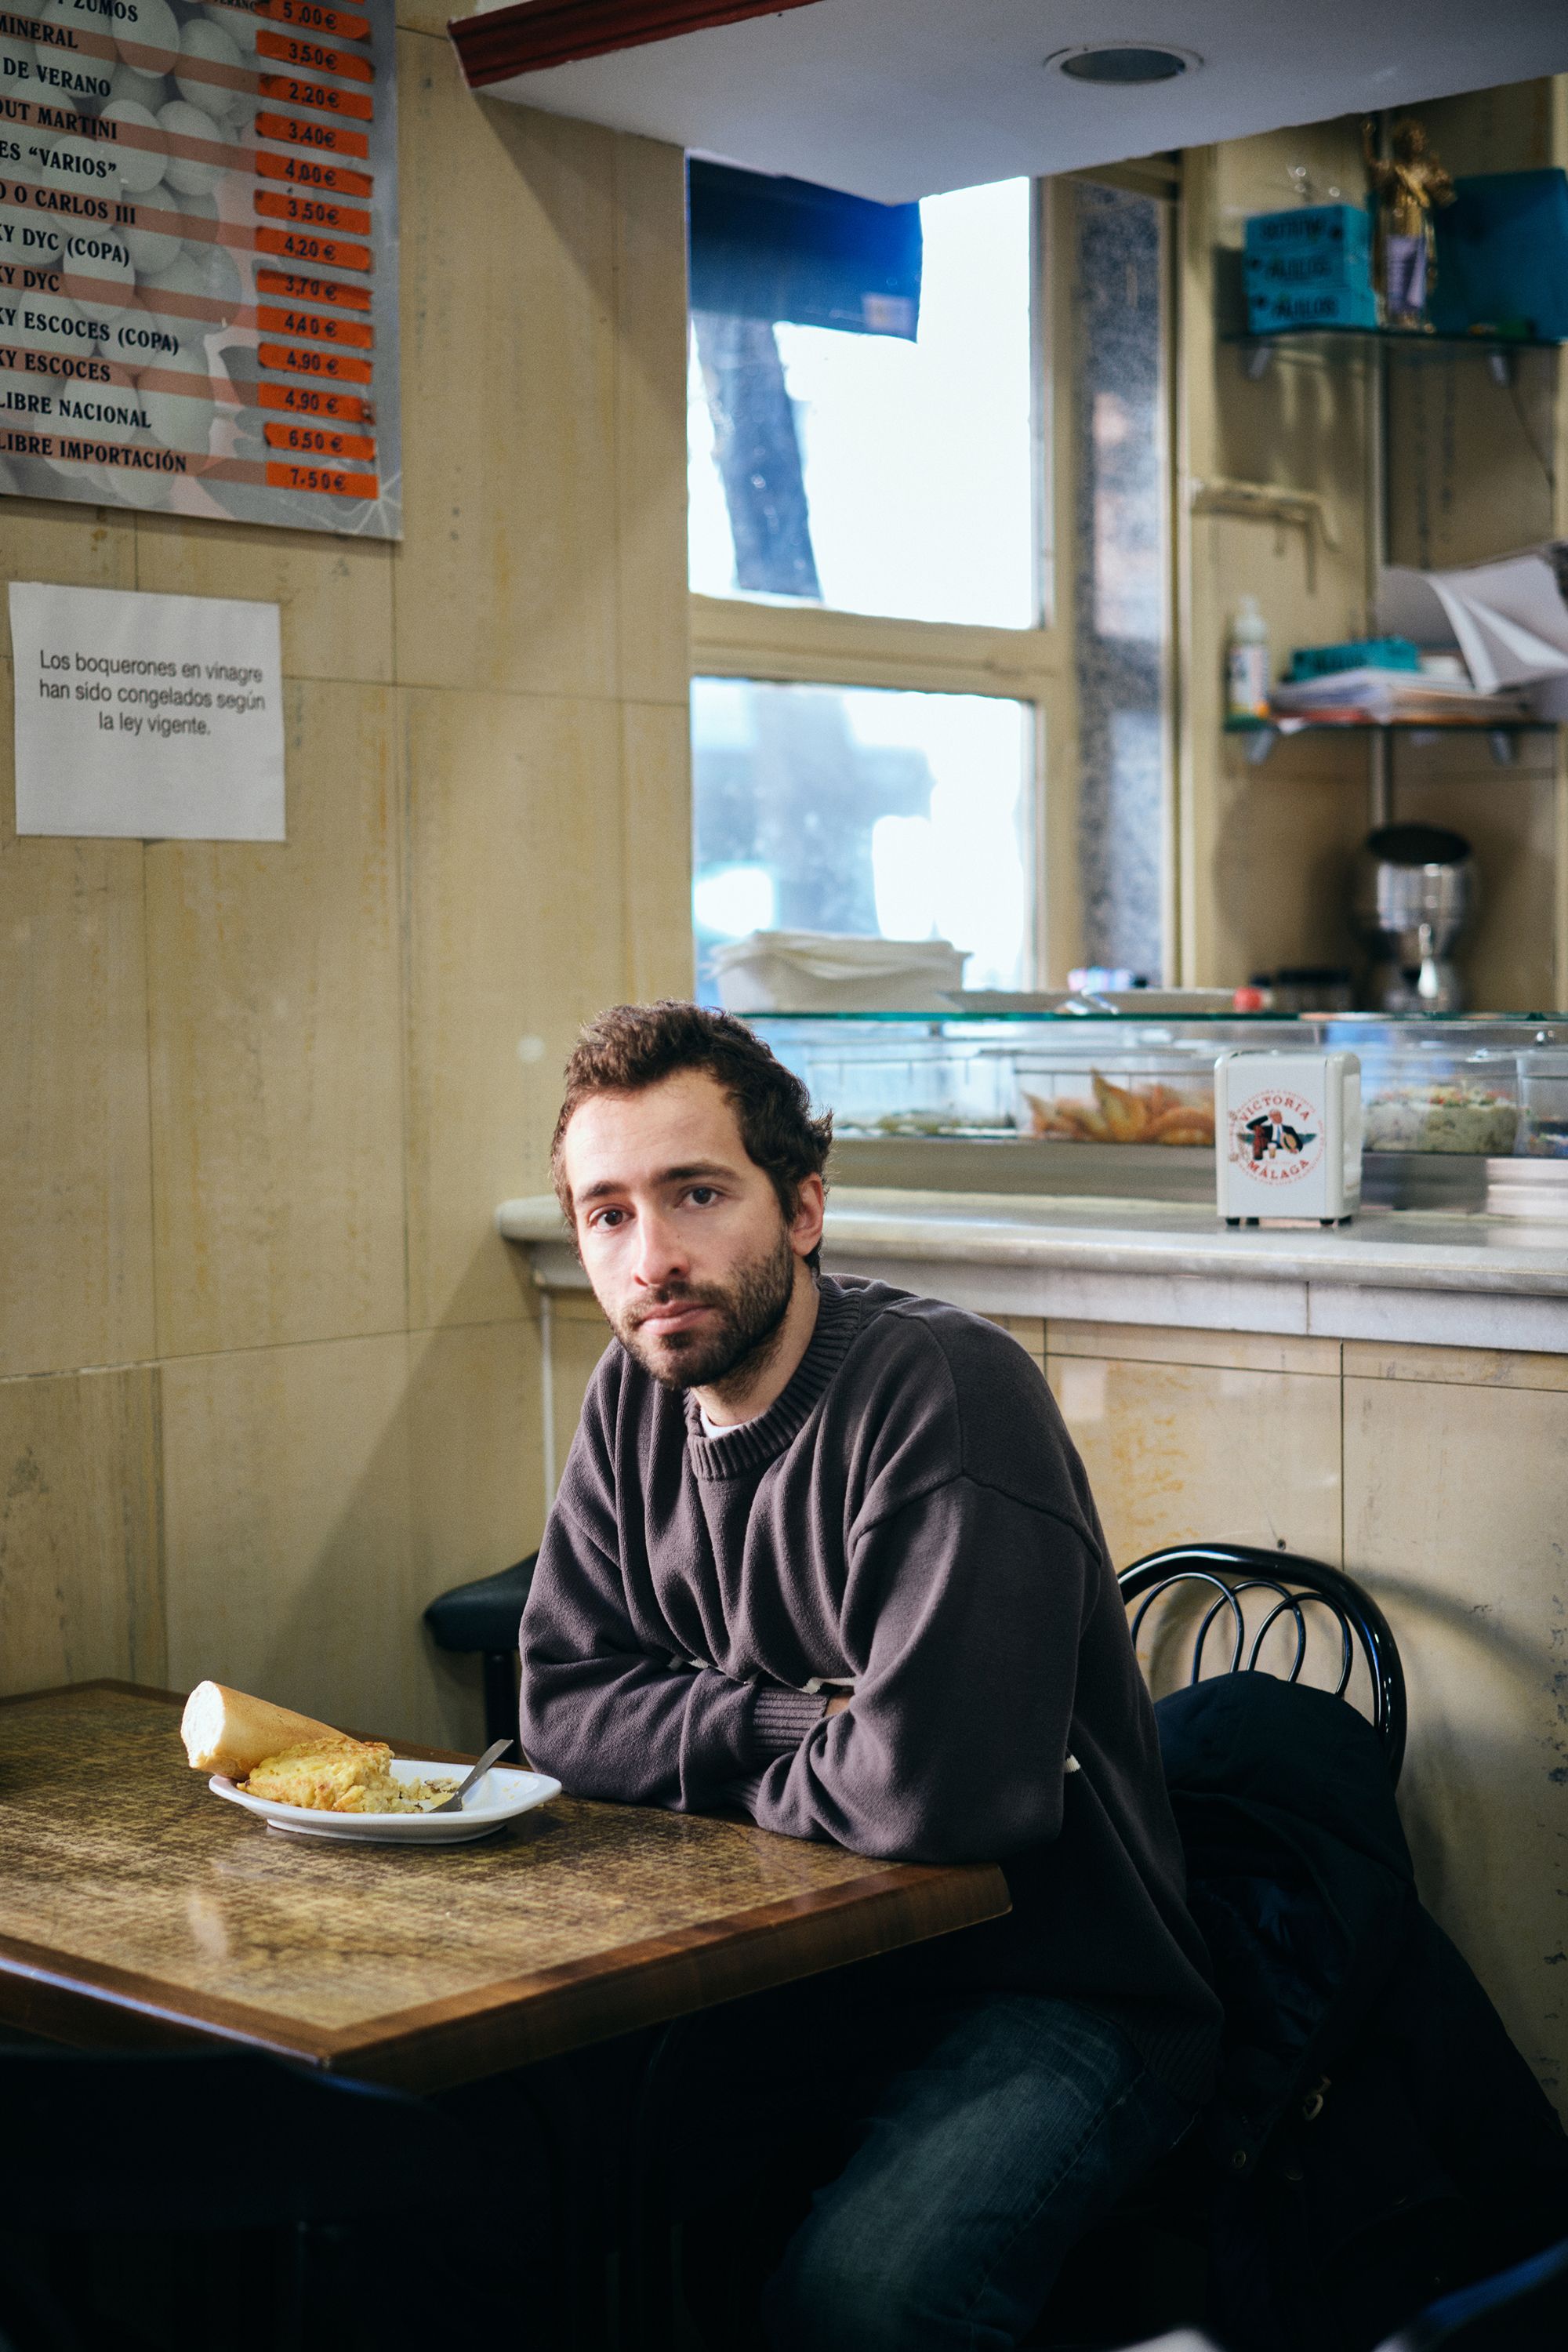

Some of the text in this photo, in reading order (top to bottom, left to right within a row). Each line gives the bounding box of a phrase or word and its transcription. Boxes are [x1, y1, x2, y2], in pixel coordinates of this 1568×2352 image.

[3, 56, 111, 97] DE VERANO
[38, 107, 118, 140] MARTINI
[14, 185, 27, 203] O
[35, 190, 108, 220] CARLOS
[114, 205, 136, 225] III
[23, 228, 59, 251] DYC
[67, 238, 129, 267] (COPA)
[24, 270, 60, 292] DYC
[24, 311, 110, 341] ESCOCES
[118, 328, 180, 356] (COPA)
[25, 354, 111, 382] ESCOCES
[60, 399, 151, 429] NACIONAL
[60, 441, 187, 472] IMPORTACIÓN
[40, 650, 263, 686] Los boquerones en vinagre
[39, 679, 265, 714] han sido congelados según
[100, 711, 211, 738] la ley vigente.
[1240, 1095, 1310, 1121] VICTORIA
